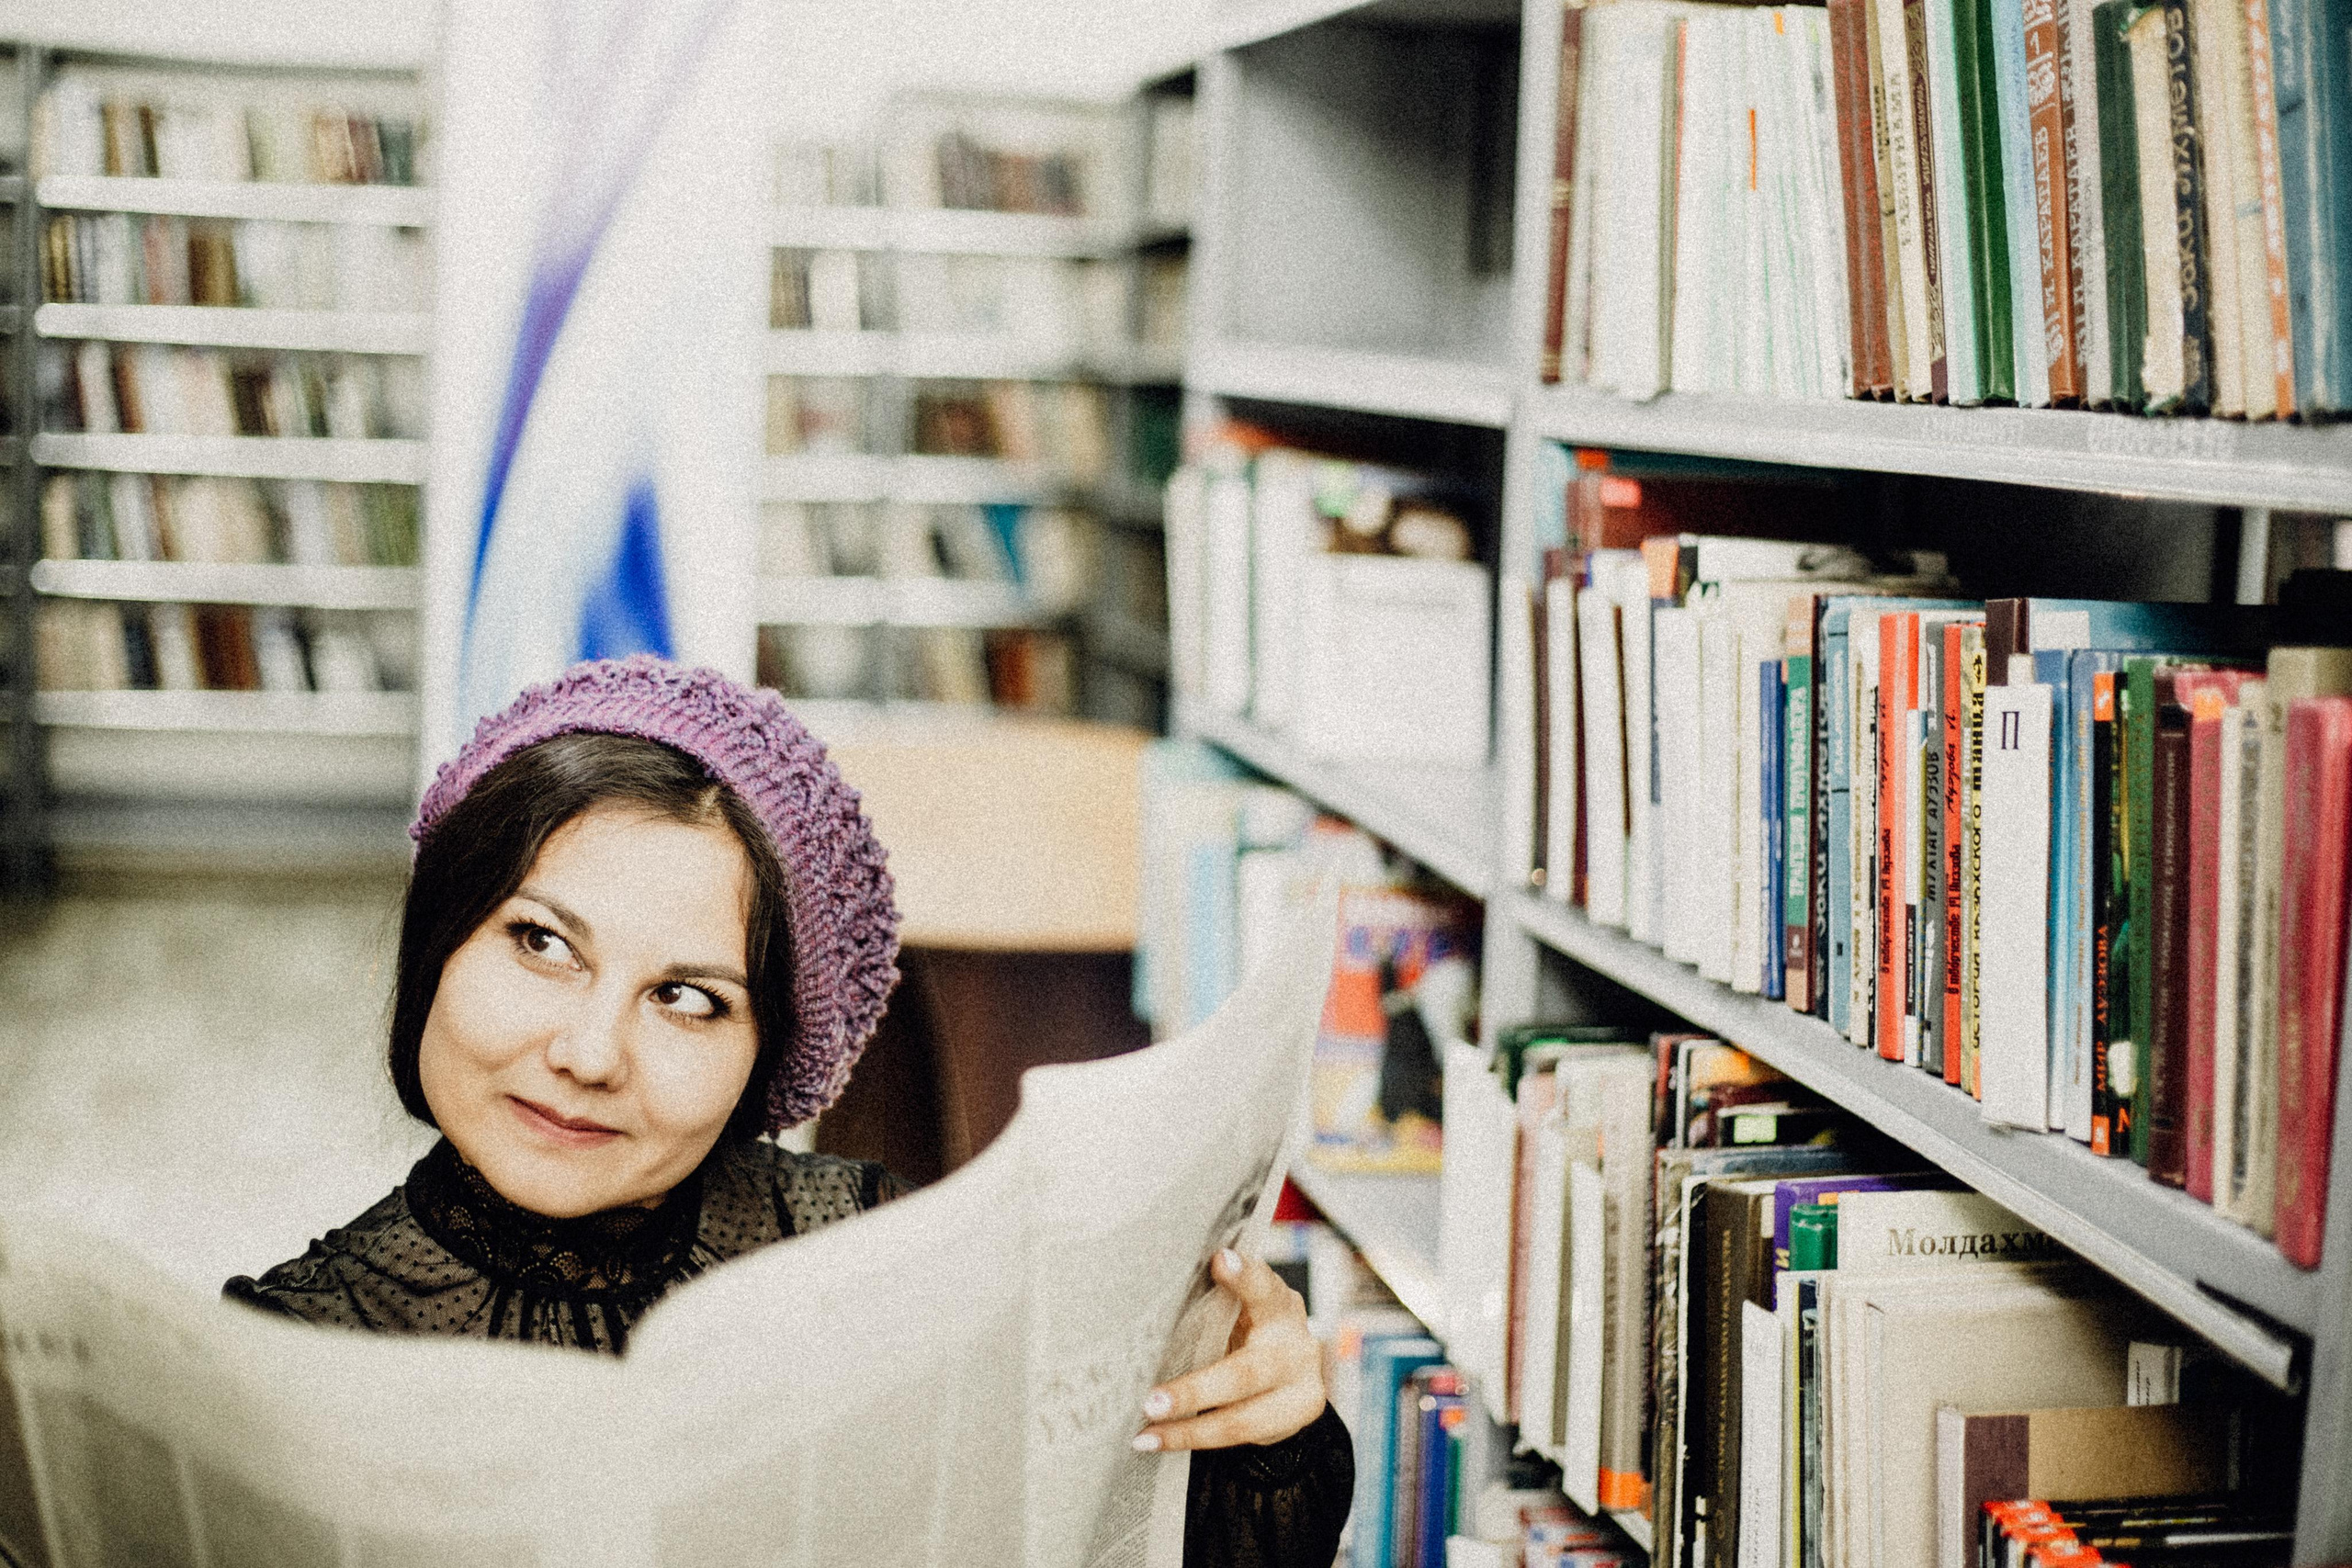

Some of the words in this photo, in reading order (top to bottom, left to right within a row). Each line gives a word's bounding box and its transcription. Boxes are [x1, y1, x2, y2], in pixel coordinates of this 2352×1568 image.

[2034, 126, 2053, 275] КАРАТАЕВ
[1789, 684, 1808, 810] ТРИУМФАТОРА
[2001, 711, 2020, 750] П
[1928, 750, 1939, 818] АУЭЗОВ
[1788, 814, 1805, 897] ТРАГЕДИЯ
[1927, 826, 1939, 902] МУХТАР
[2095, 925, 2109, 1025] АУЭЗОВА
[2095, 1040, 2108, 1092] МИР
